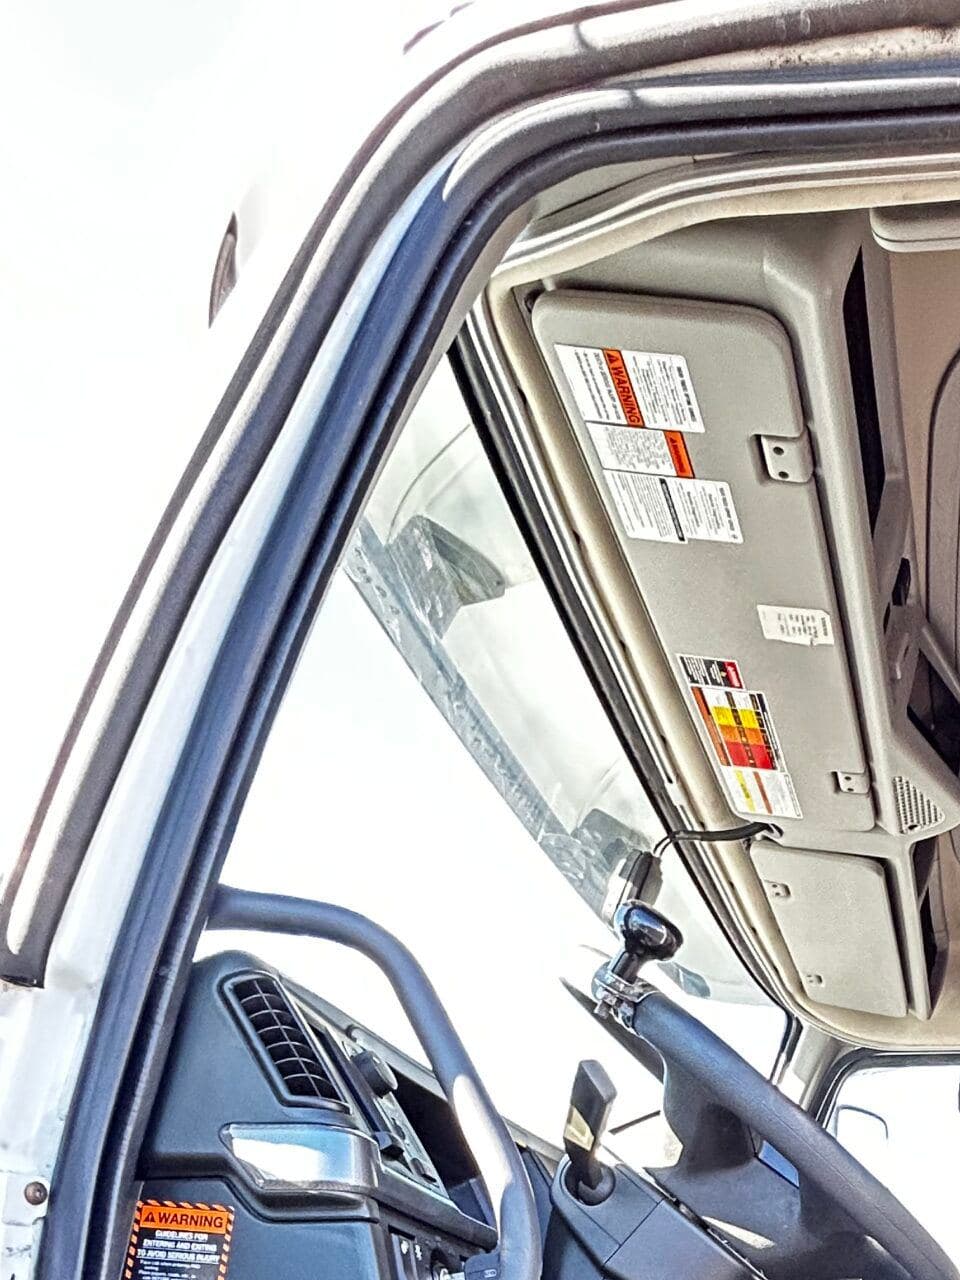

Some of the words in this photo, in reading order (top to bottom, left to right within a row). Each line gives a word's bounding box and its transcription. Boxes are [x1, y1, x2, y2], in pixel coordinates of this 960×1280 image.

[611, 366, 640, 424] WARNING
[158, 1212, 223, 1229] WARNING
[155, 1230, 193, 1240] GUIDELINES
[143, 1239, 176, 1248] ENTERING
[176, 1241, 191, 1250] AND
[191, 1243, 217, 1252] EXITING
[137, 1249, 146, 1257] TO
[147, 1250, 167, 1259] AVOID
[167, 1251, 196, 1261] SERIOUS
[196, 1253, 220, 1263] INJURY
